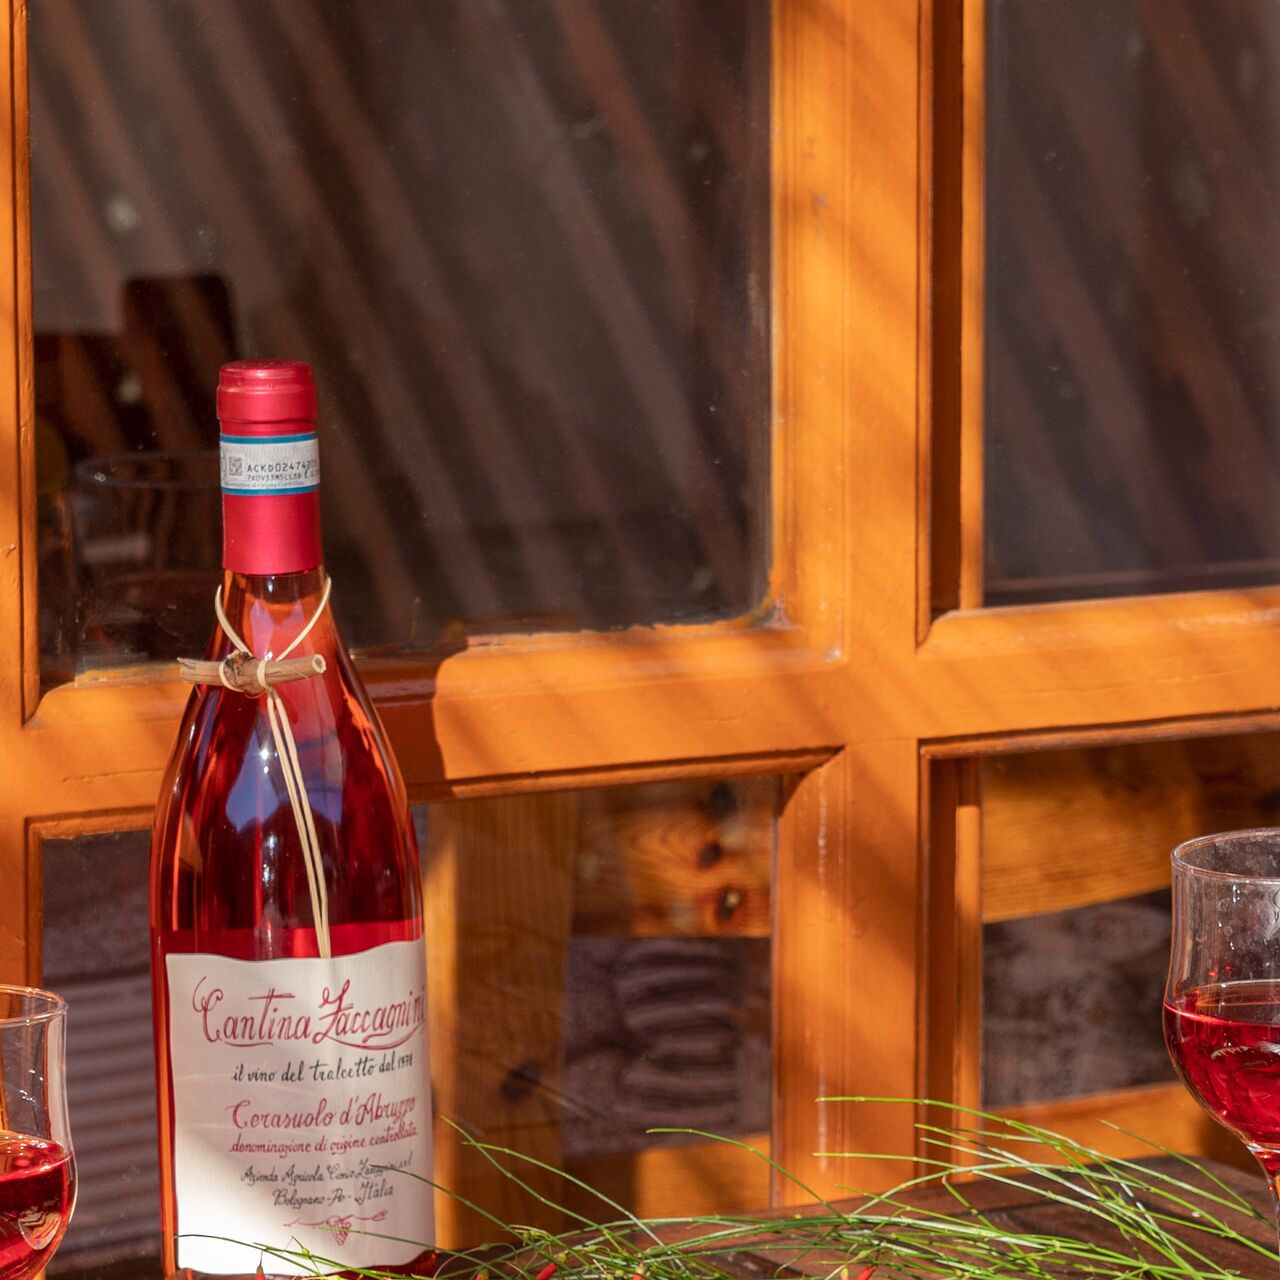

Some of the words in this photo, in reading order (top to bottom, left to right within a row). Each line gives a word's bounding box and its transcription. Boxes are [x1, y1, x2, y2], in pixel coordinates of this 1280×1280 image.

[193, 976, 312, 1047] Cantina
[231, 1064, 244, 1082] il
[247, 1068, 277, 1082] vino
[281, 1060, 305, 1082] del
[309, 1054, 376, 1082] tralcetto
[379, 1051, 396, 1074] dal
[225, 1098, 337, 1129] Cerasuolo
[339, 1092, 417, 1127] d'Abruzzo
[229, 1133, 312, 1159] denominazione
[314, 1134, 328, 1152] di
[330, 1135, 367, 1156] origine
[354, 1178, 394, 1206] Italia
